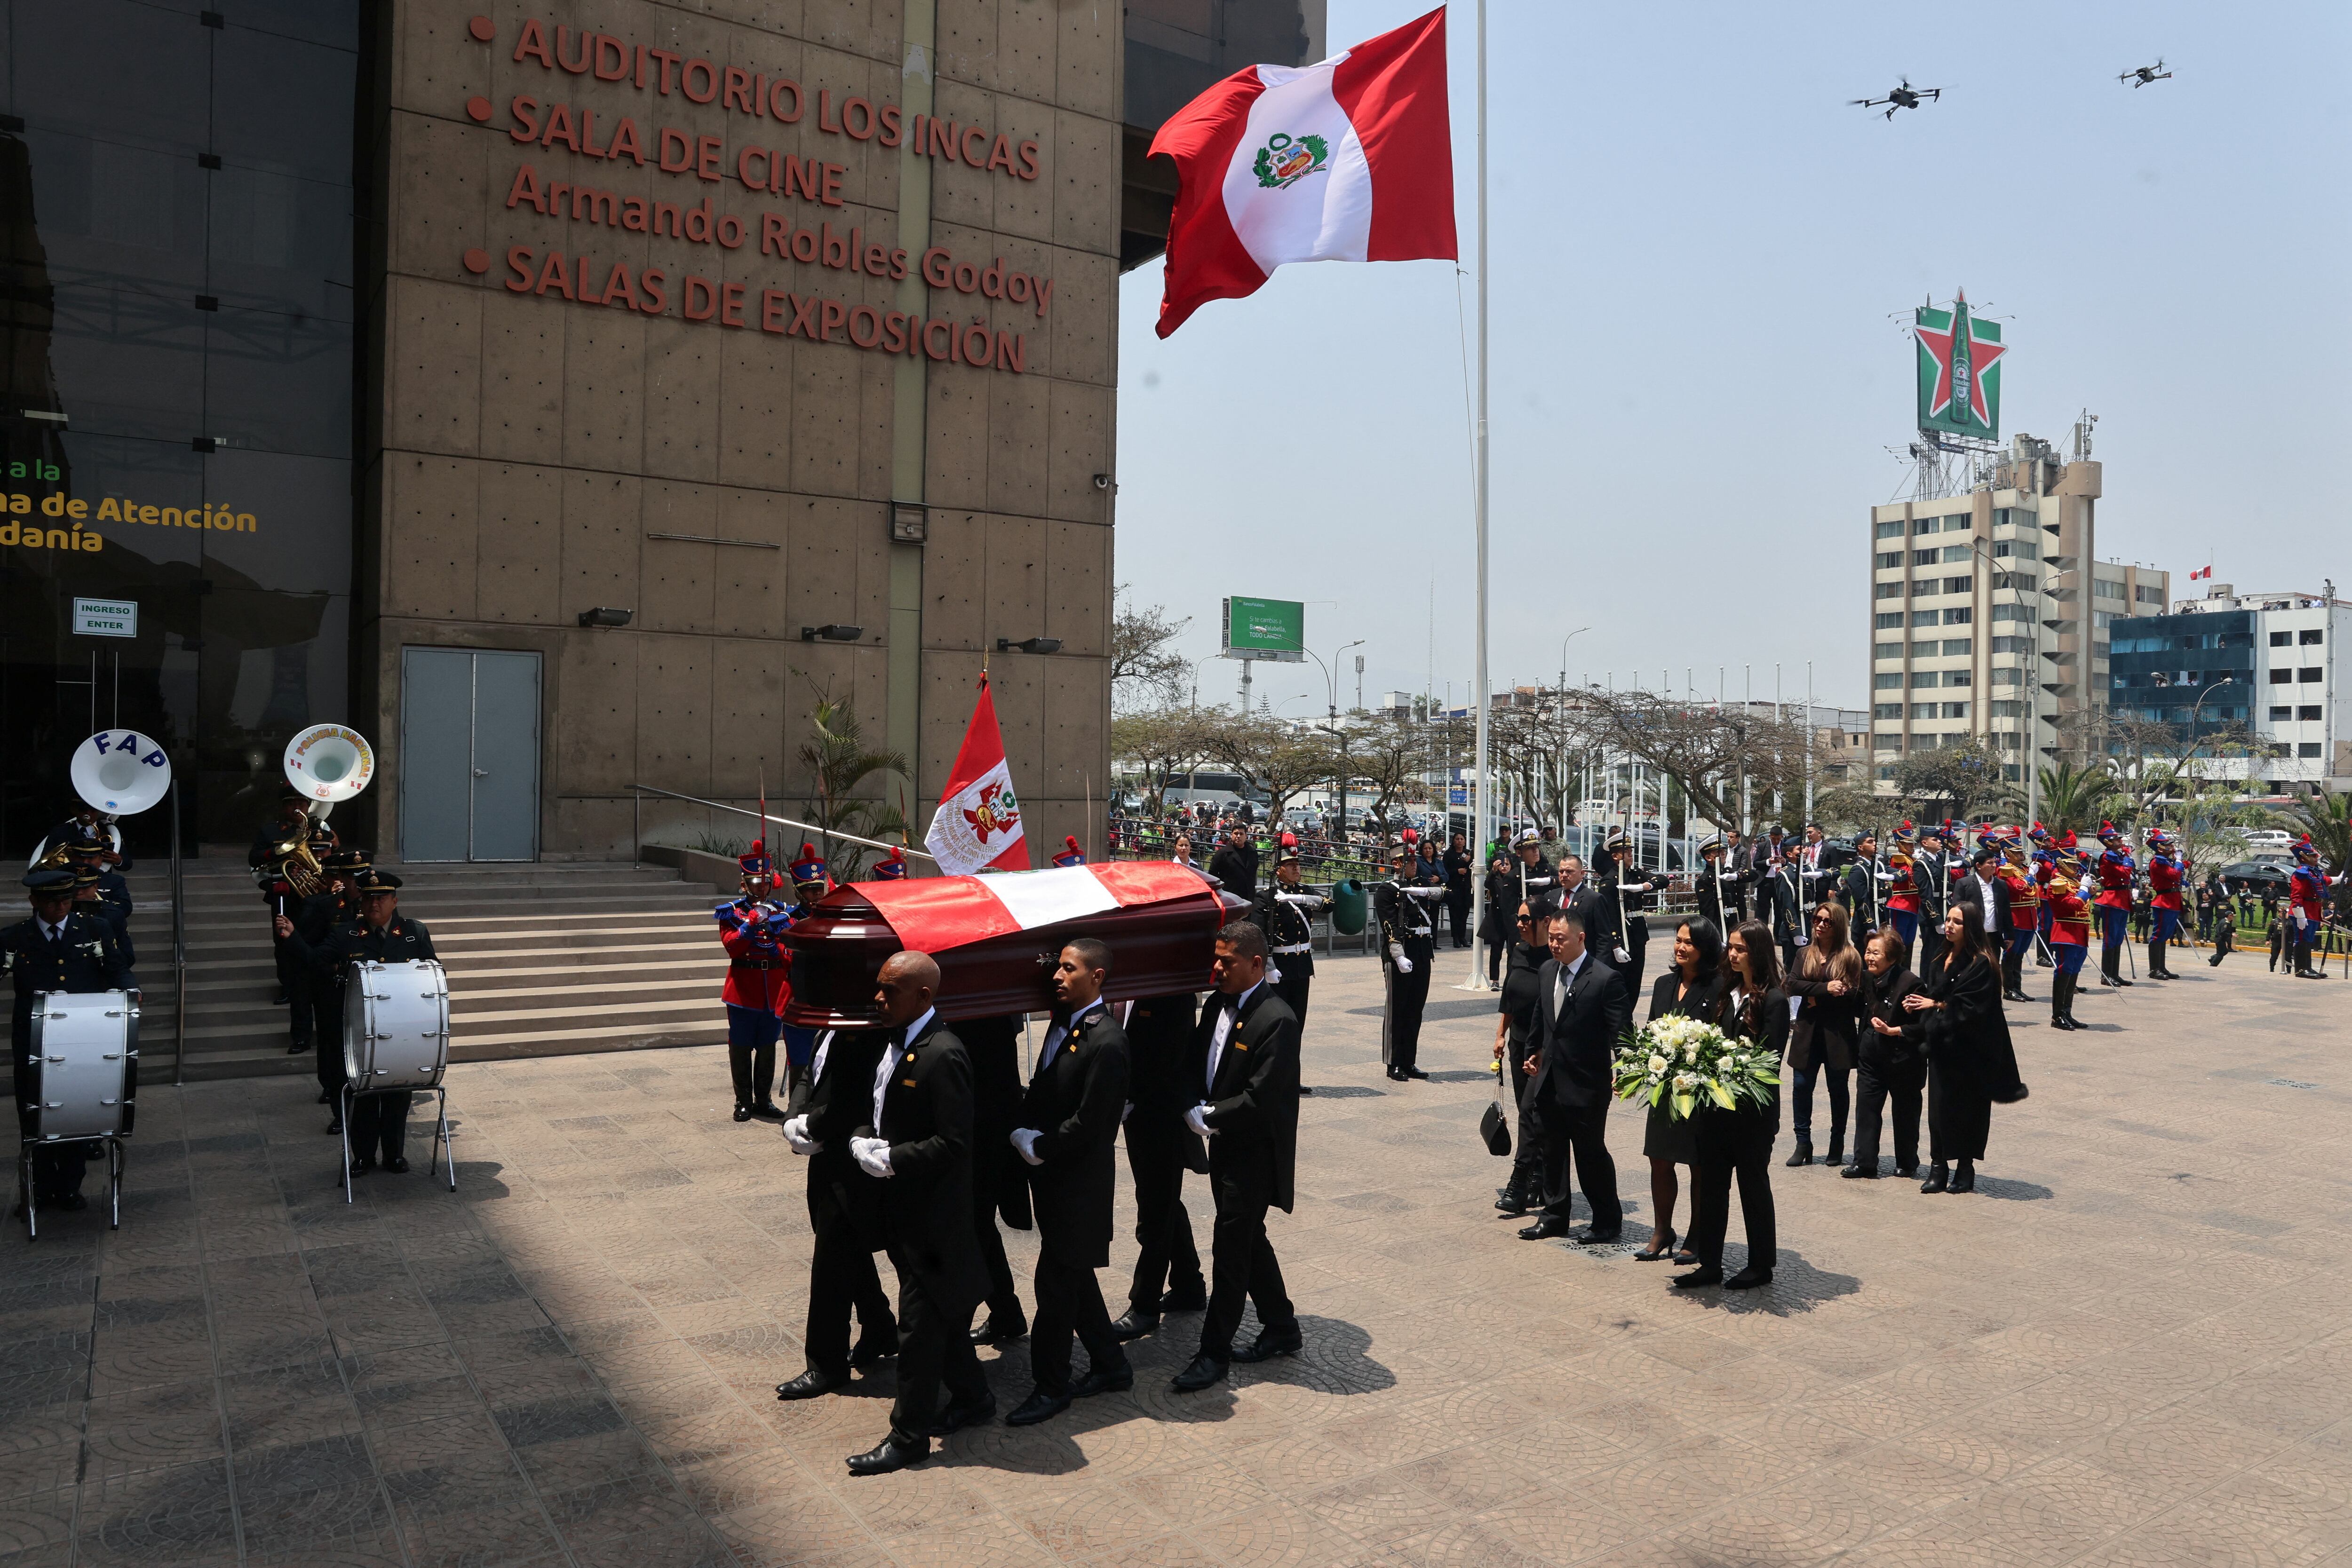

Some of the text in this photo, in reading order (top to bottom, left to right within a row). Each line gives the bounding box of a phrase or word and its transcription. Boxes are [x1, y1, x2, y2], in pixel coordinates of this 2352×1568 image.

[513, 18, 1039, 181] AUDITORIO LOS INCAS
[509, 95, 844, 207] SALA DE CINE
[507, 164, 1055, 317] Armando Robles Godoy
[506, 245, 1025, 374] SALAS DE EXPOSICIÓN
[36, 459, 60, 481] la
[41, 491, 88, 519] de
[97, 498, 256, 532] Atención
[81, 605, 130, 614] INGRESO
[87, 620, 123, 629] ENTER
[94, 733, 166, 768] FAP
[295, 728, 371, 778] POLICIA NACIONAL
[937, 819, 954, 852] LIBERTADOR
[949, 848, 959, 859] DEL
[946, 800, 954, 825] GLORIOSO
[959, 842, 967, 851] DE
[955, 795, 964, 828] REGIMIENTO
[960, 830, 969, 840] DE
